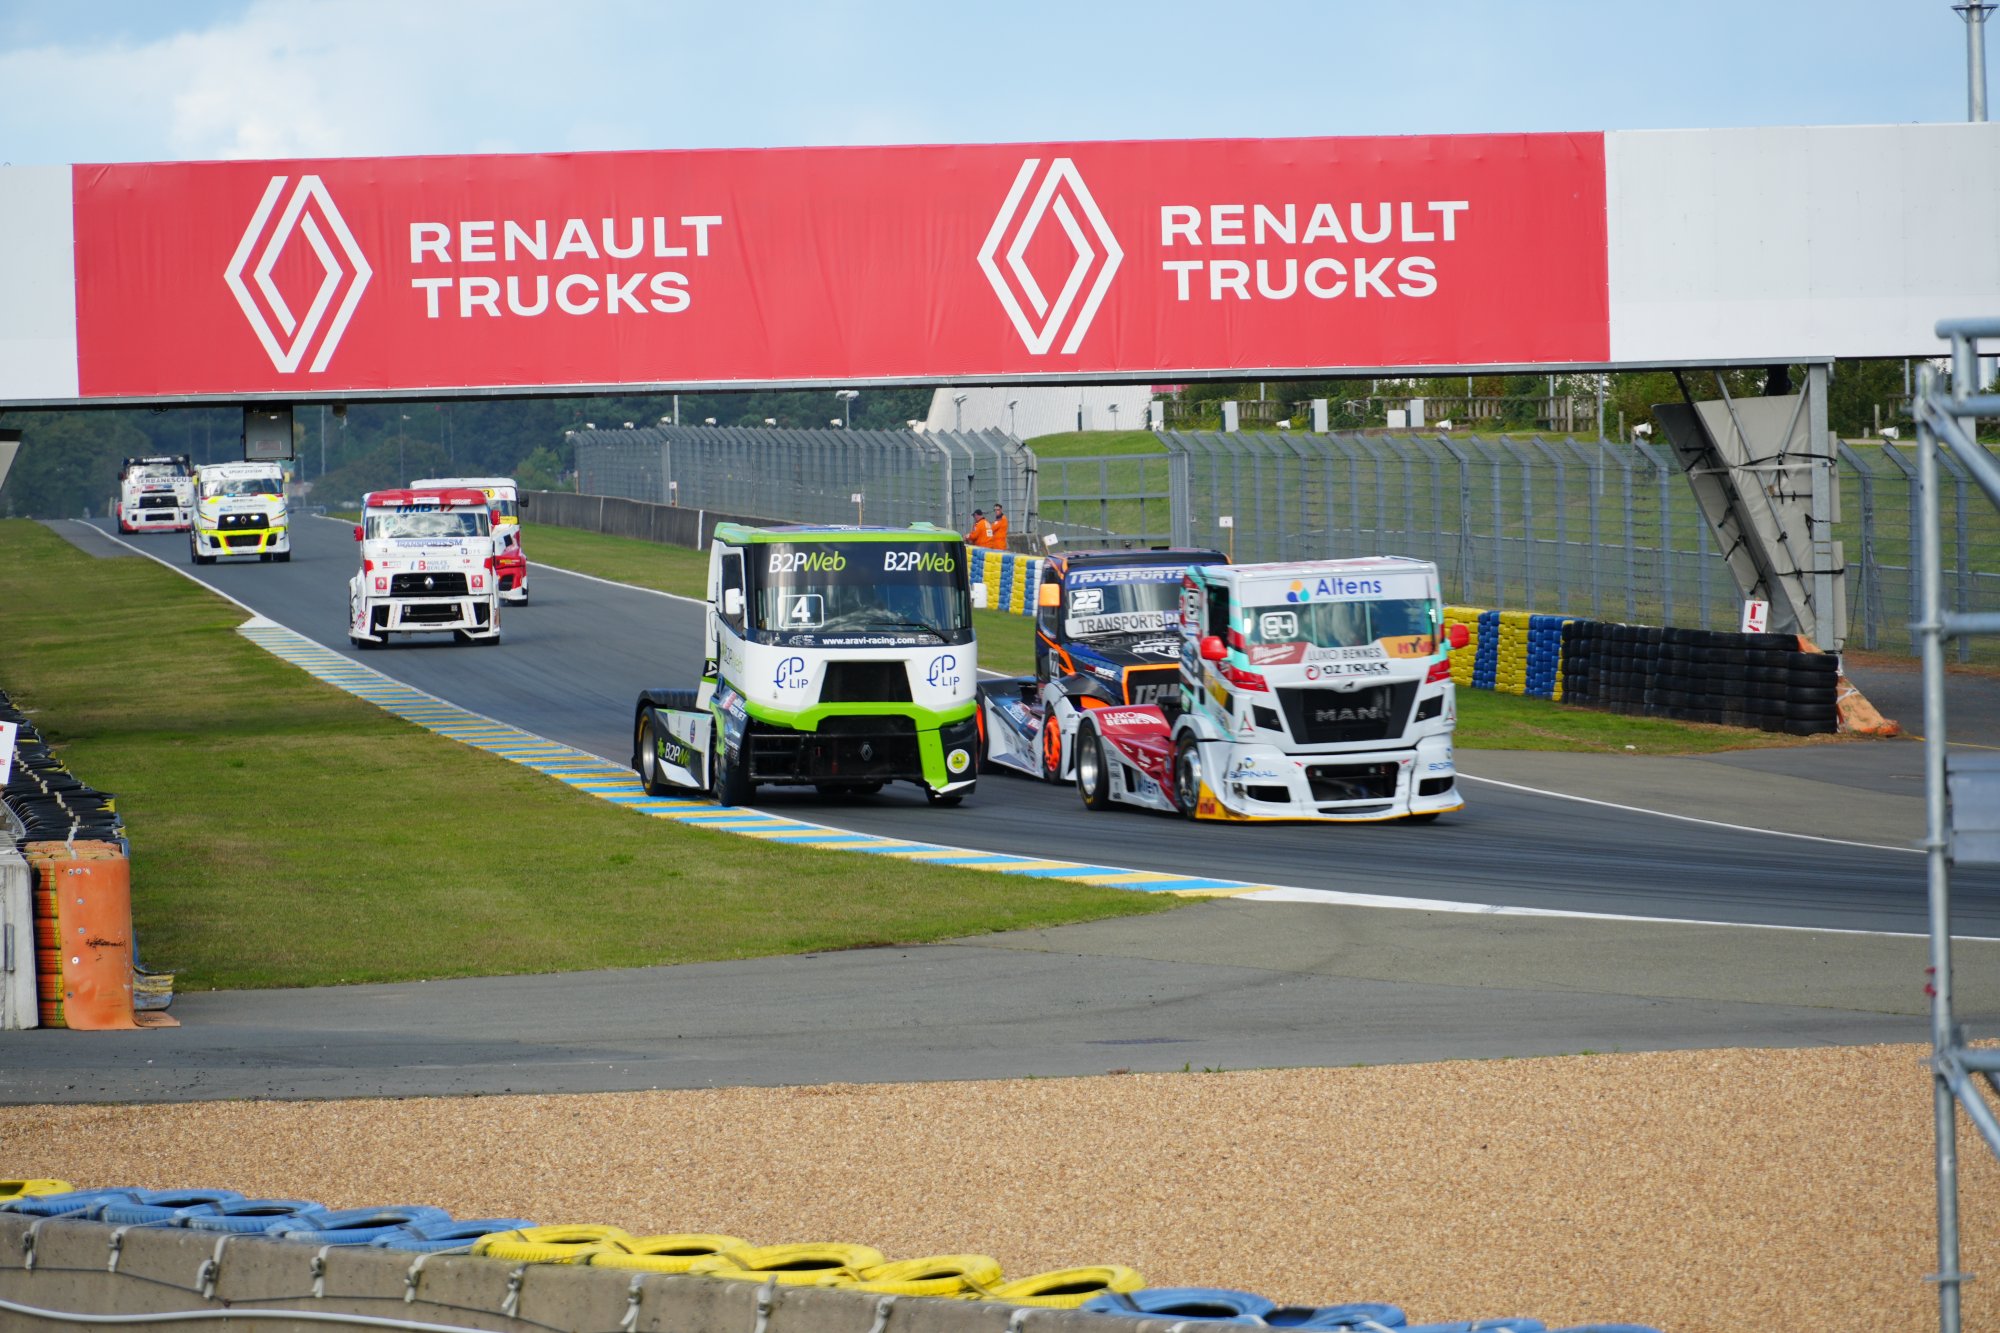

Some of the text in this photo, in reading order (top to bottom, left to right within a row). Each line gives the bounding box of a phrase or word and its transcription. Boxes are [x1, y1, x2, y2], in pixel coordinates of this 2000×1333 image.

[1160, 200, 1469, 246] RENAULT
[410, 215, 722, 263] RENAULT
[1162, 256, 1438, 301] TRUCKS
[411, 271, 691, 318] TRUCKS
[768, 551, 847, 573] B2PWeb
[884, 551, 955, 573] B2PWeb
[1069, 570, 1185, 584] TRANSPORTS
[1316, 577, 1383, 596] Altens
[791, 596, 811, 623] 4
[1072, 590, 1101, 611] 22
[1079, 614, 1163, 633] TRANSPORTS
[1264, 616, 1293, 636] 94
[822, 636, 916, 645] www.aravi-racing.com
[1346, 661, 1390, 673] TRUCK
[1103, 711, 1137, 720] LUXO
[1315, 706, 1378, 721] MAN
